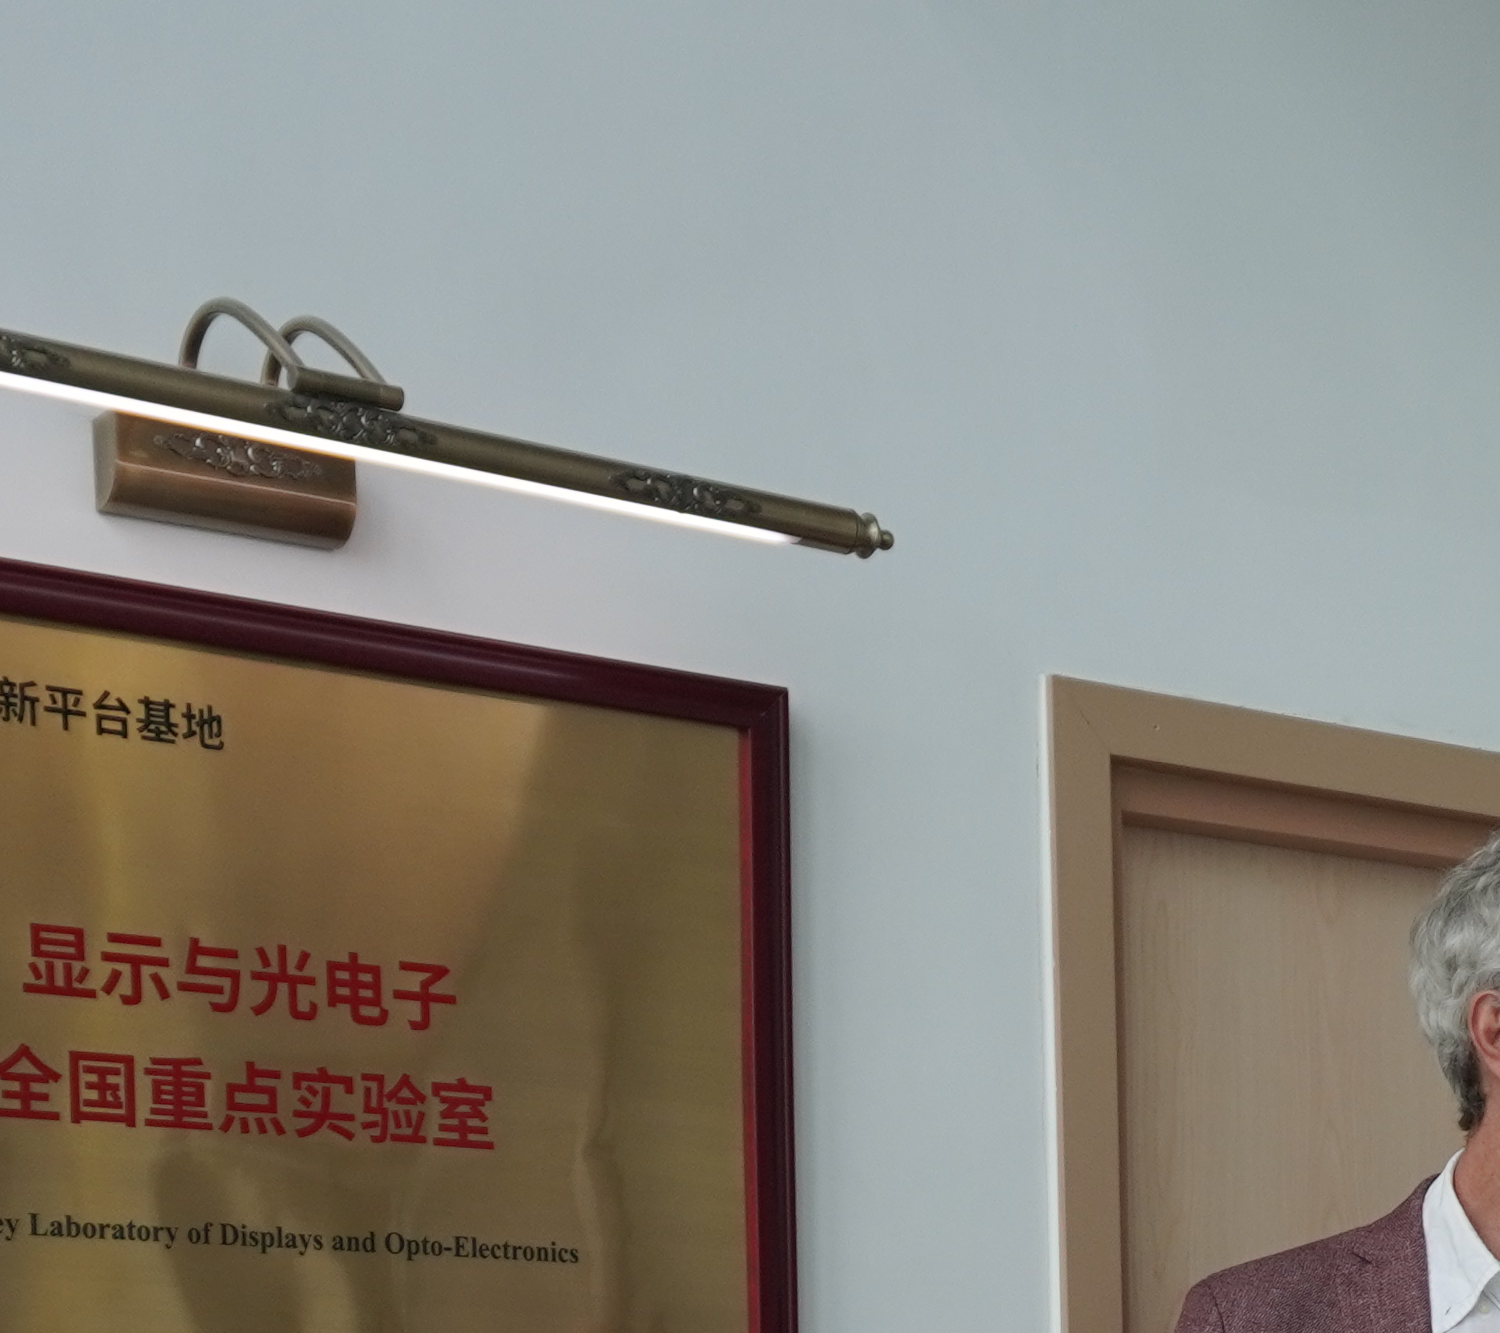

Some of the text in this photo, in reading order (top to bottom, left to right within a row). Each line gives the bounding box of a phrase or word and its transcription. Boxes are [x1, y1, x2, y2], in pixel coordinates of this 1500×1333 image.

[23, 923, 457, 1031] 显示与光电子
[28, 1213, 179, 1249] Laboratory
[187, 1222, 214, 1245] of
[220, 1223, 323, 1255] Displays
[332, 1231, 376, 1253] and
[385, 1232, 580, 1264] Opto-Electronics
